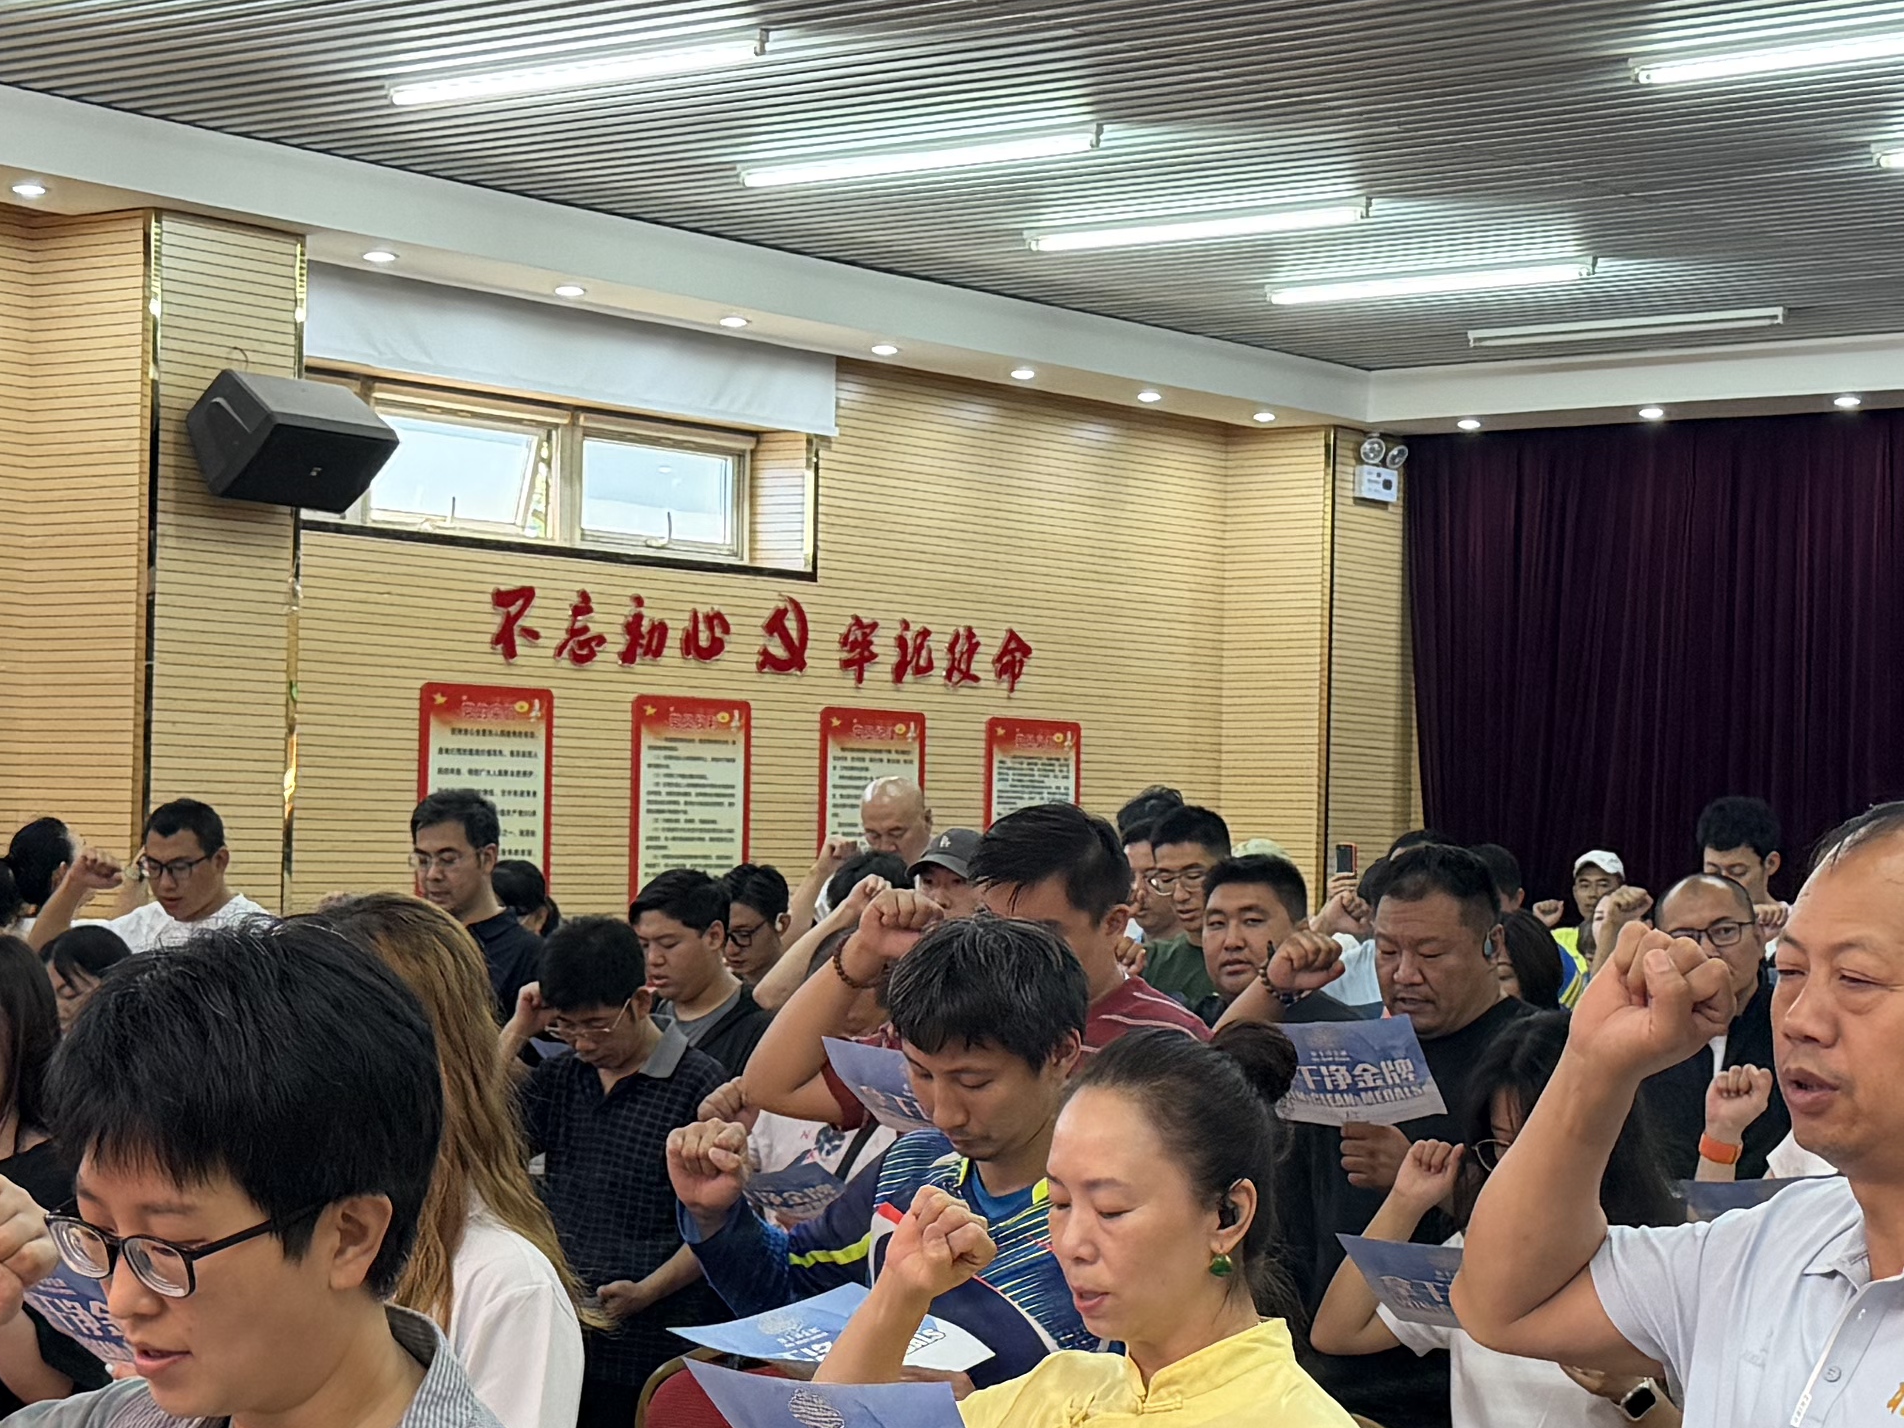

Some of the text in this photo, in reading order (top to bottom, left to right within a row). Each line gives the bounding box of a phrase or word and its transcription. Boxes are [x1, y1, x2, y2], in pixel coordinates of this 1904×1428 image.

[491, 586, 1033, 692] 不忘初心 牢记使命
